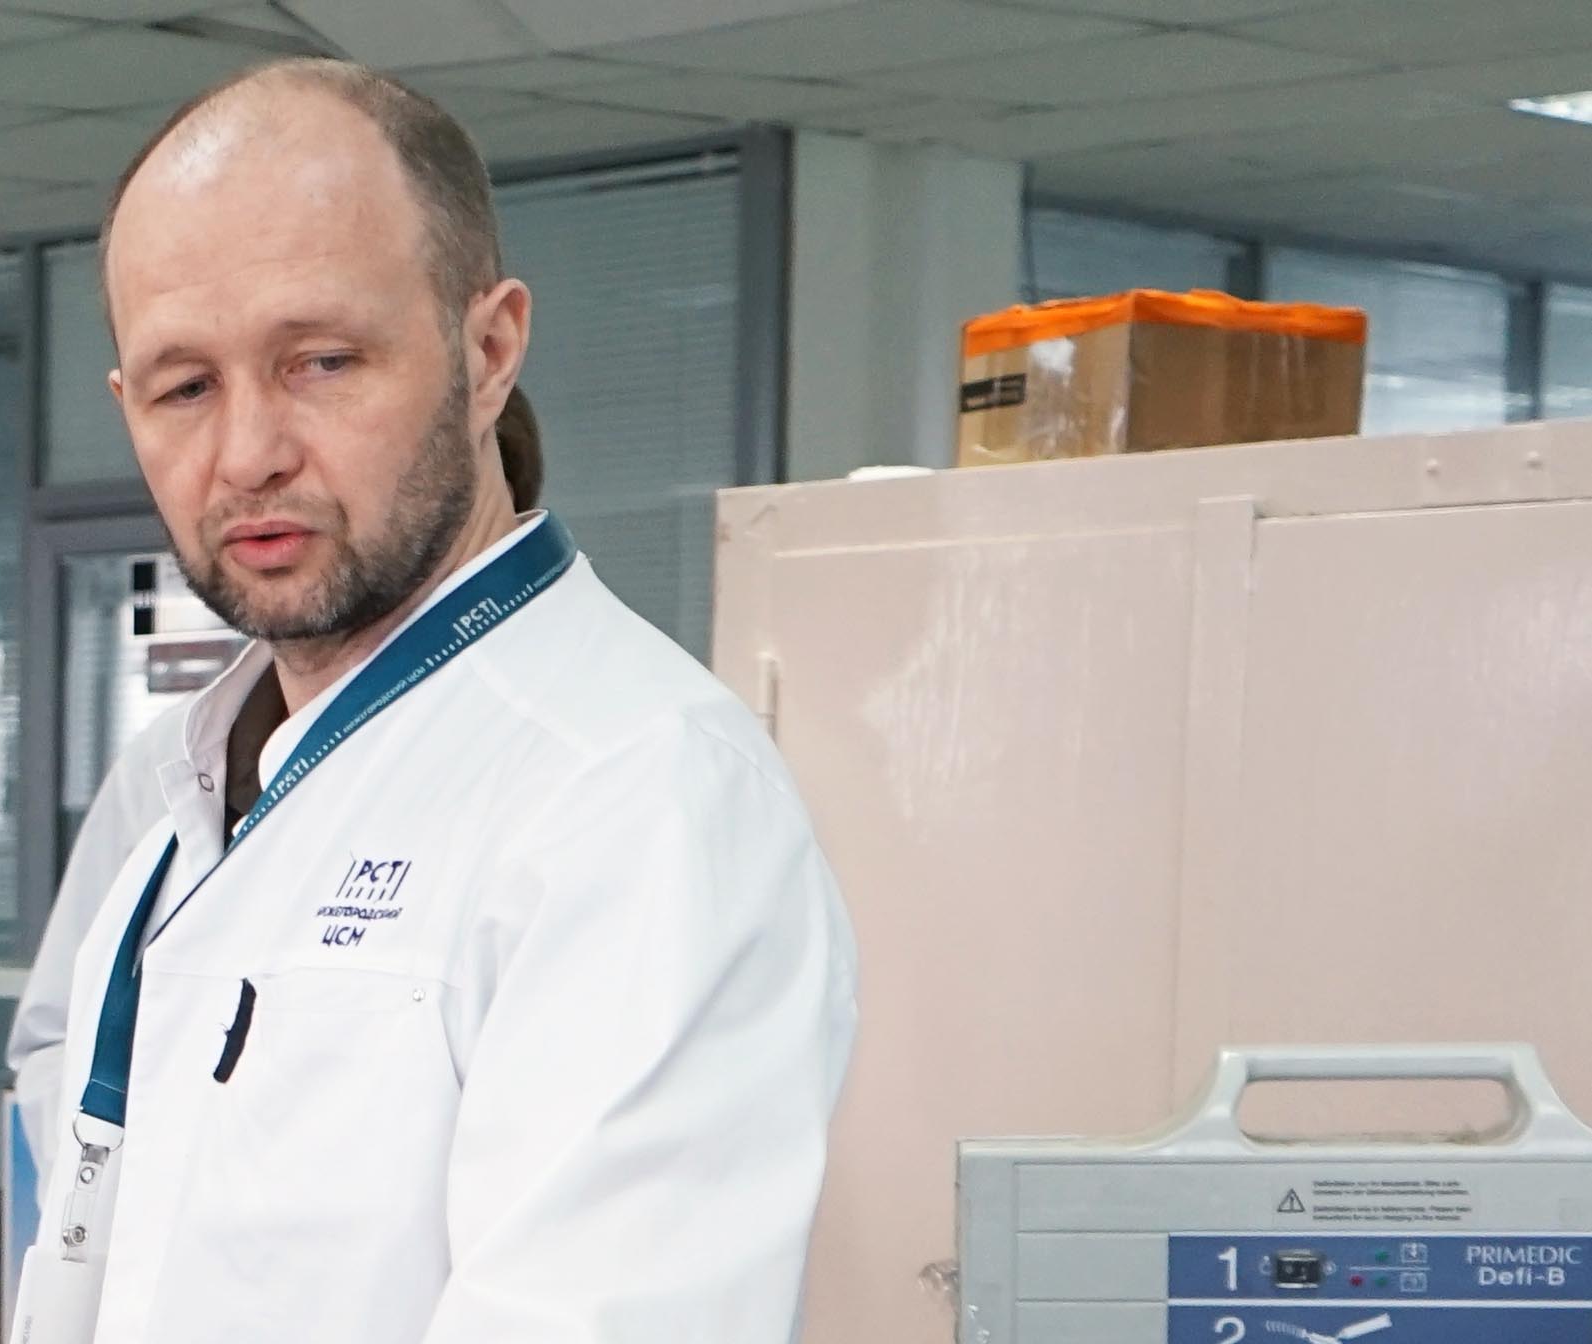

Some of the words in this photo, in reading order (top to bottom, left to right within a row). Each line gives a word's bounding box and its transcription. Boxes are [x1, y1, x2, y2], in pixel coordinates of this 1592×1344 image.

[353, 859, 404, 884] РСТ
[321, 924, 367, 947] ЦСМ
[1467, 1245, 1582, 1265] PRIMEDIC
[1217, 1247, 1238, 1291] 1
[1478, 1266, 1566, 1286] Defi-B
